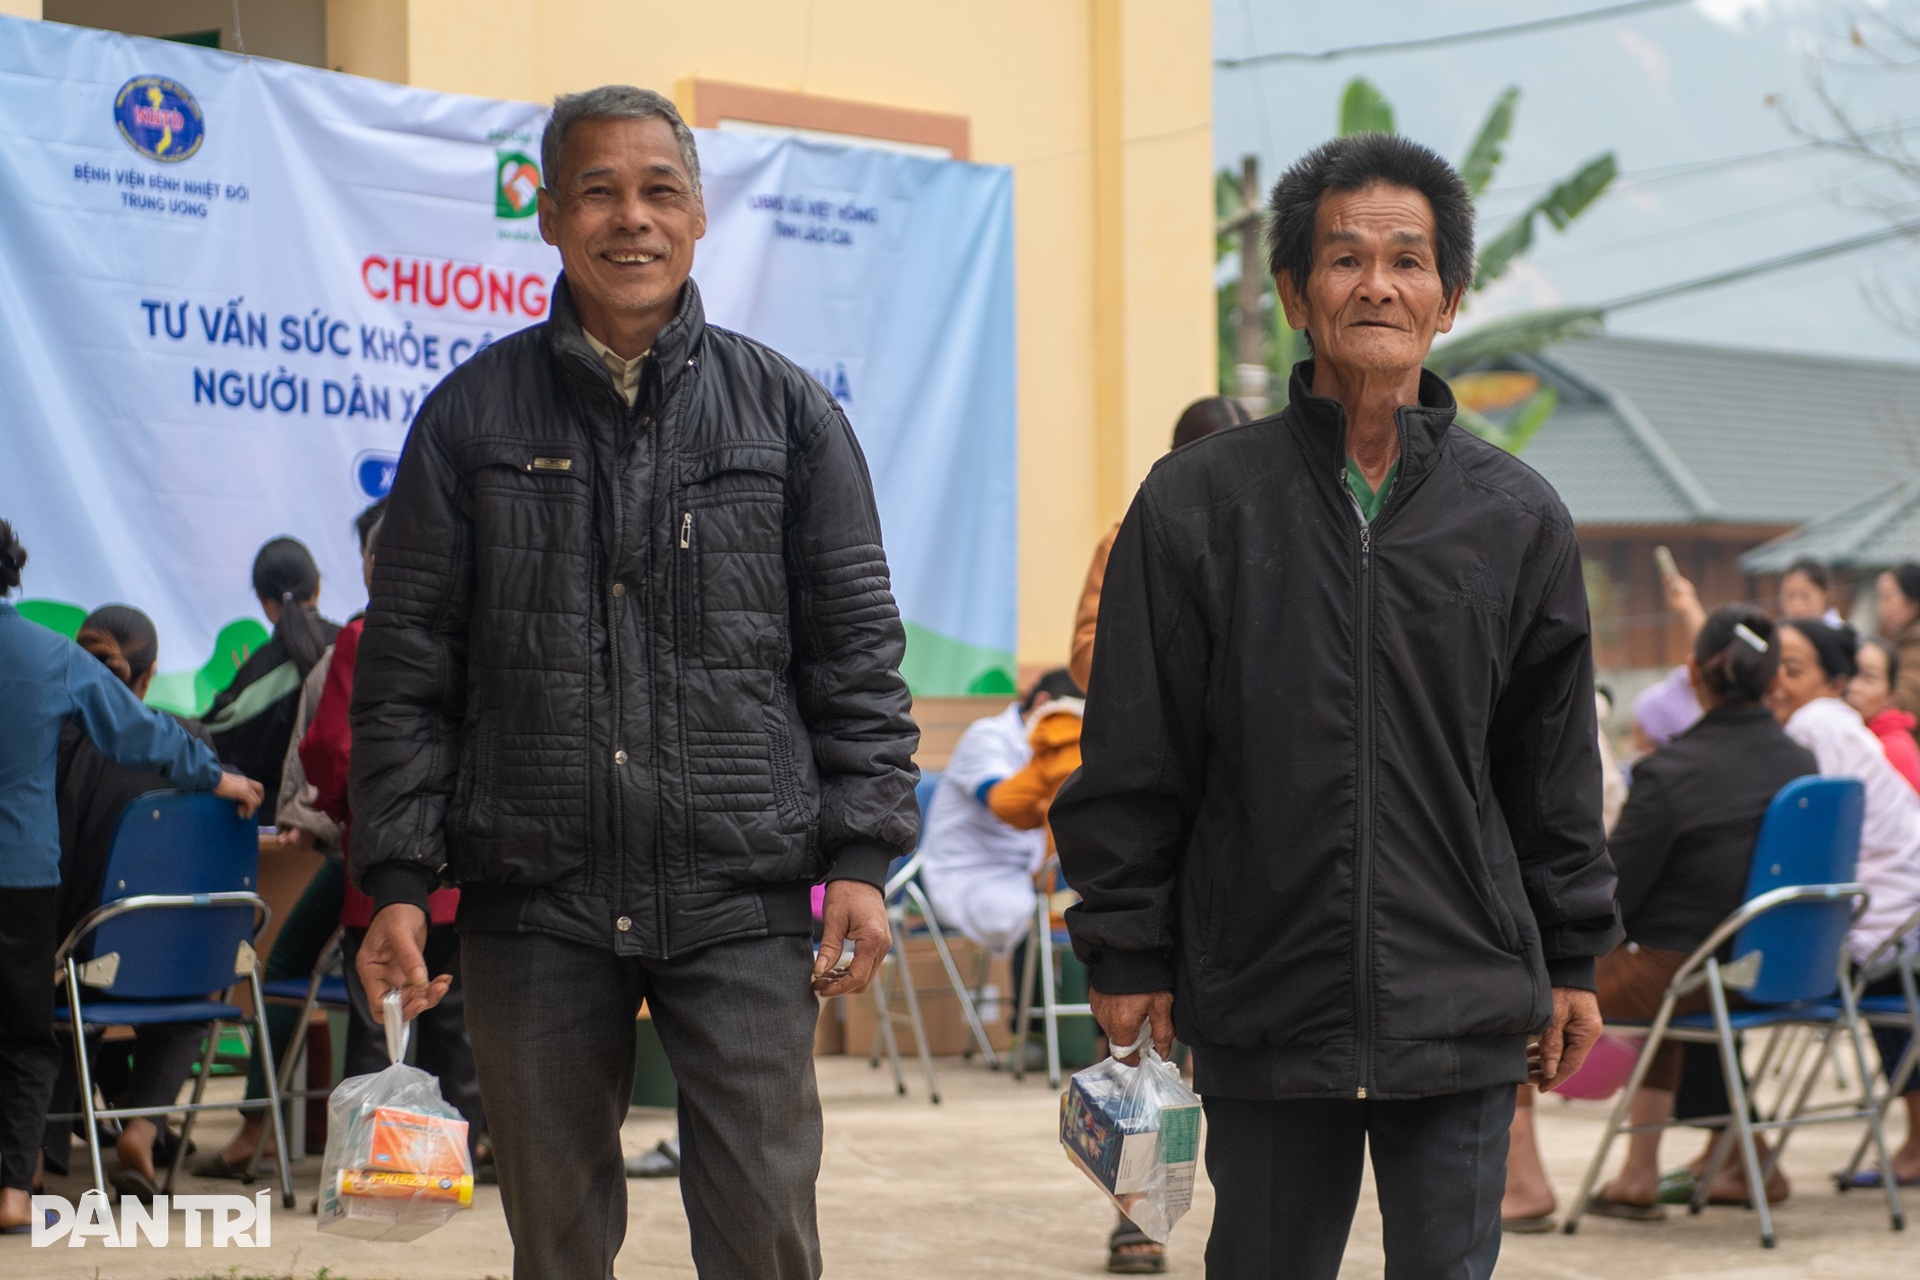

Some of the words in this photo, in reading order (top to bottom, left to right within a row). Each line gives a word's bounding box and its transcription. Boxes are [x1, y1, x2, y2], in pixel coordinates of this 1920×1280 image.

[74, 162, 111, 184] BỆNH
[115, 168, 145, 189] VIỆN
[149, 172, 181, 193] BỆNH
[184, 179, 221, 201] NHIỆT
[121, 191, 165, 211] TRUNG
[170, 197, 208, 217] ƯƠNG
[361, 254, 549, 317] CHƯƠNG
[141, 298, 190, 339] TƯ
[199, 295, 268, 349] VẤN
[280, 307, 352, 356] SỨC
[360, 320, 440, 371] KHỎE
[193, 365, 309, 413] NGƯỜI
[323, 372, 391, 421] DÂN
